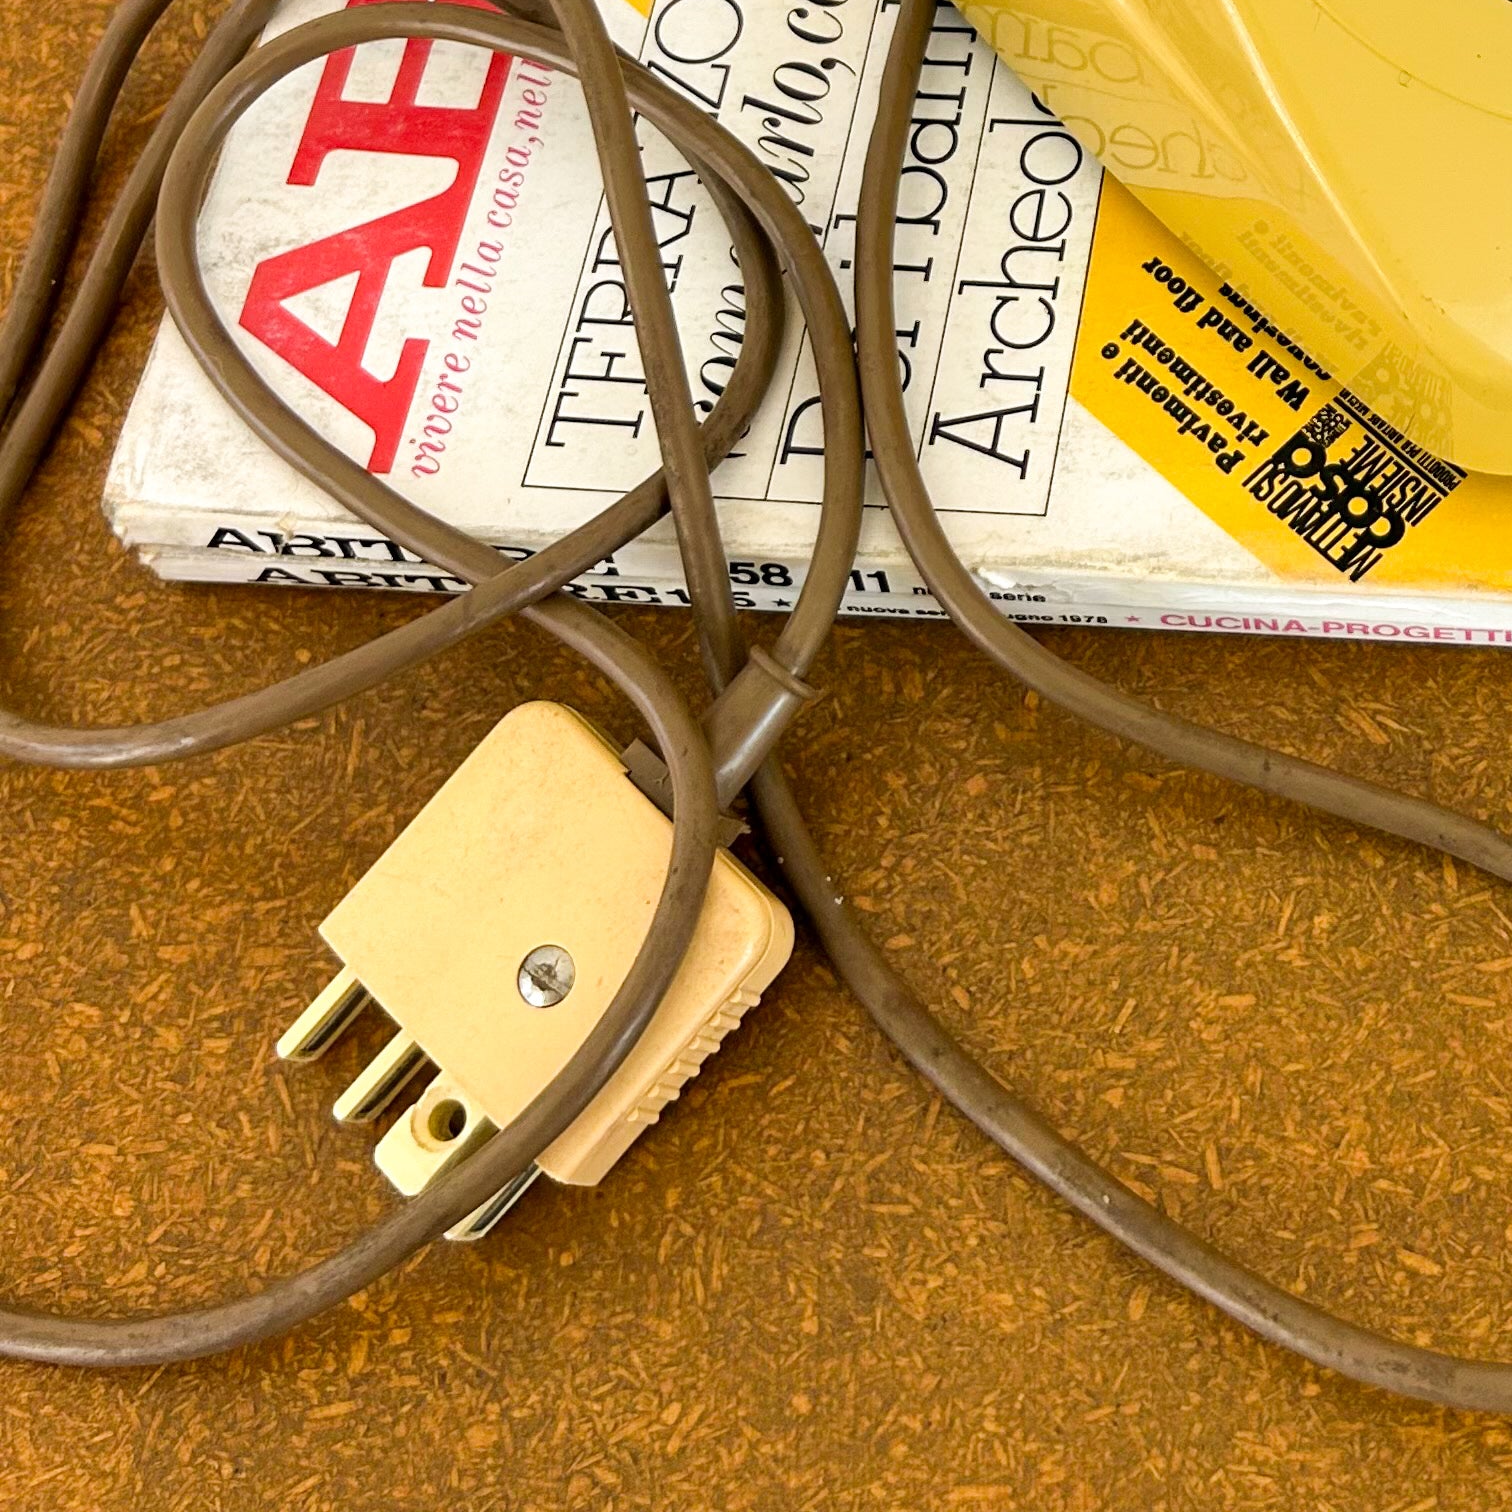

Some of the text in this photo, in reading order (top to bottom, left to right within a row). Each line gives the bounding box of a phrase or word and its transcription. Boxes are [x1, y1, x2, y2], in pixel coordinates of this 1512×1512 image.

[929, 93, 1085, 480] Archeol
[1141, 256, 1206, 314] floor
[411, 354, 470, 478] vivere
[452, 241, 504, 343] nella
[1101, 341, 1116, 361] e
[1196, 305, 1254, 354] and
[1117, 318, 1271, 449] rivestimenti
[1246, 349, 1312, 413] Wall
[1113, 360, 1247, 477] Pavimenti
[1159, 614, 1512, 643] CUCINA-PROGETTI
